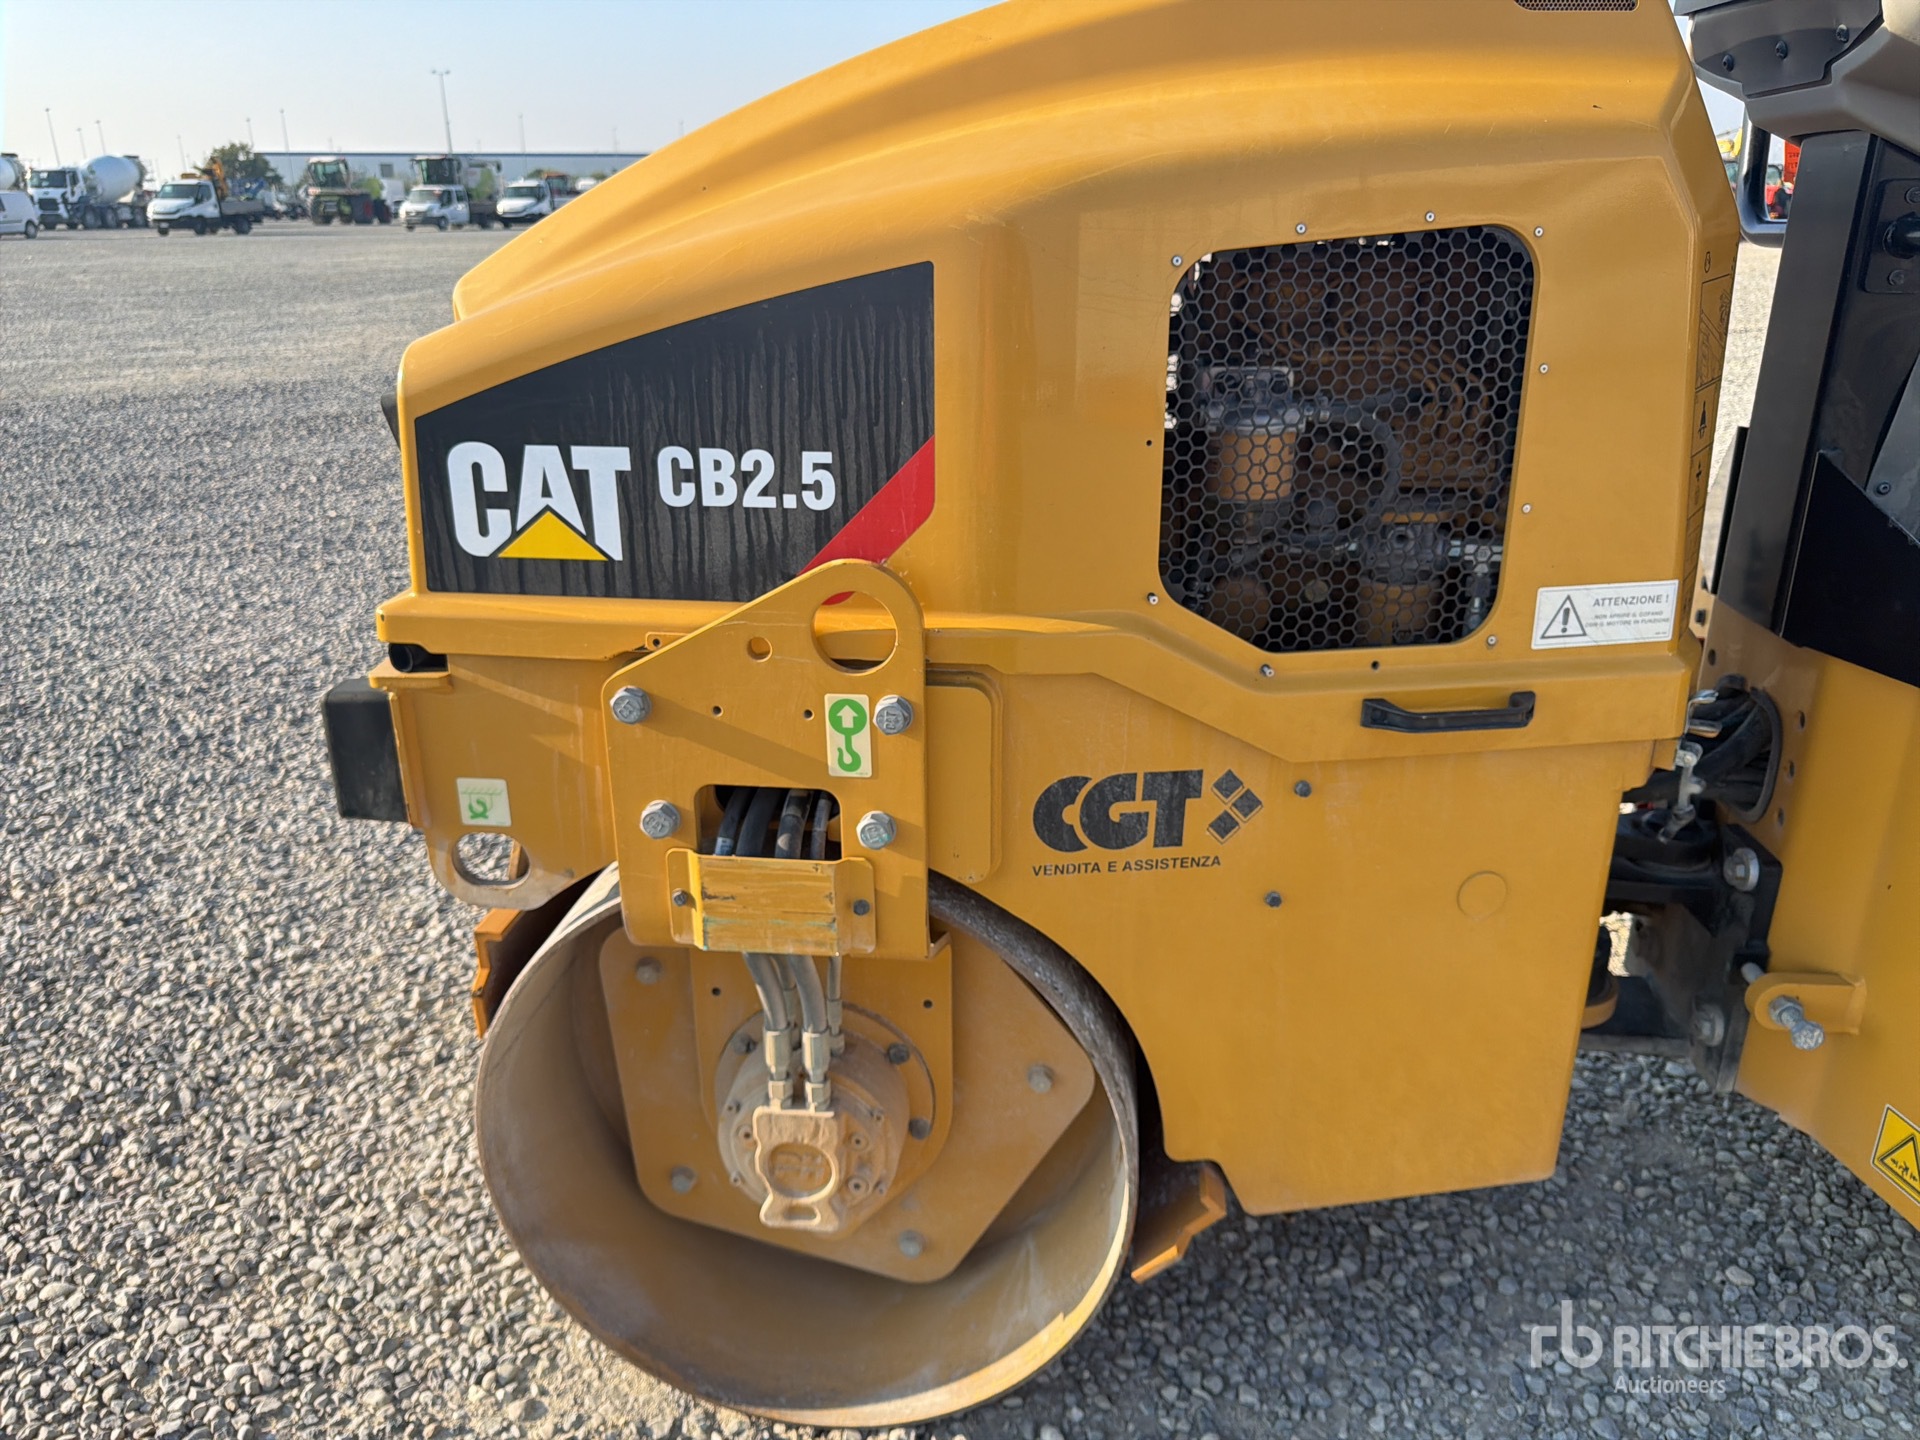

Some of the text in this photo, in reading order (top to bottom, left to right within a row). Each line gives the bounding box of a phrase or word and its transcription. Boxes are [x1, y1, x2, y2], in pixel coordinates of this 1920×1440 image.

[447, 441, 836, 561] CAT CB2.5
[1593, 595, 1662, 607] ATTENZIONE
[1033, 769, 1204, 852] CGT
[1032, 856, 1221, 877] VENDITA E ASSISTENZA
